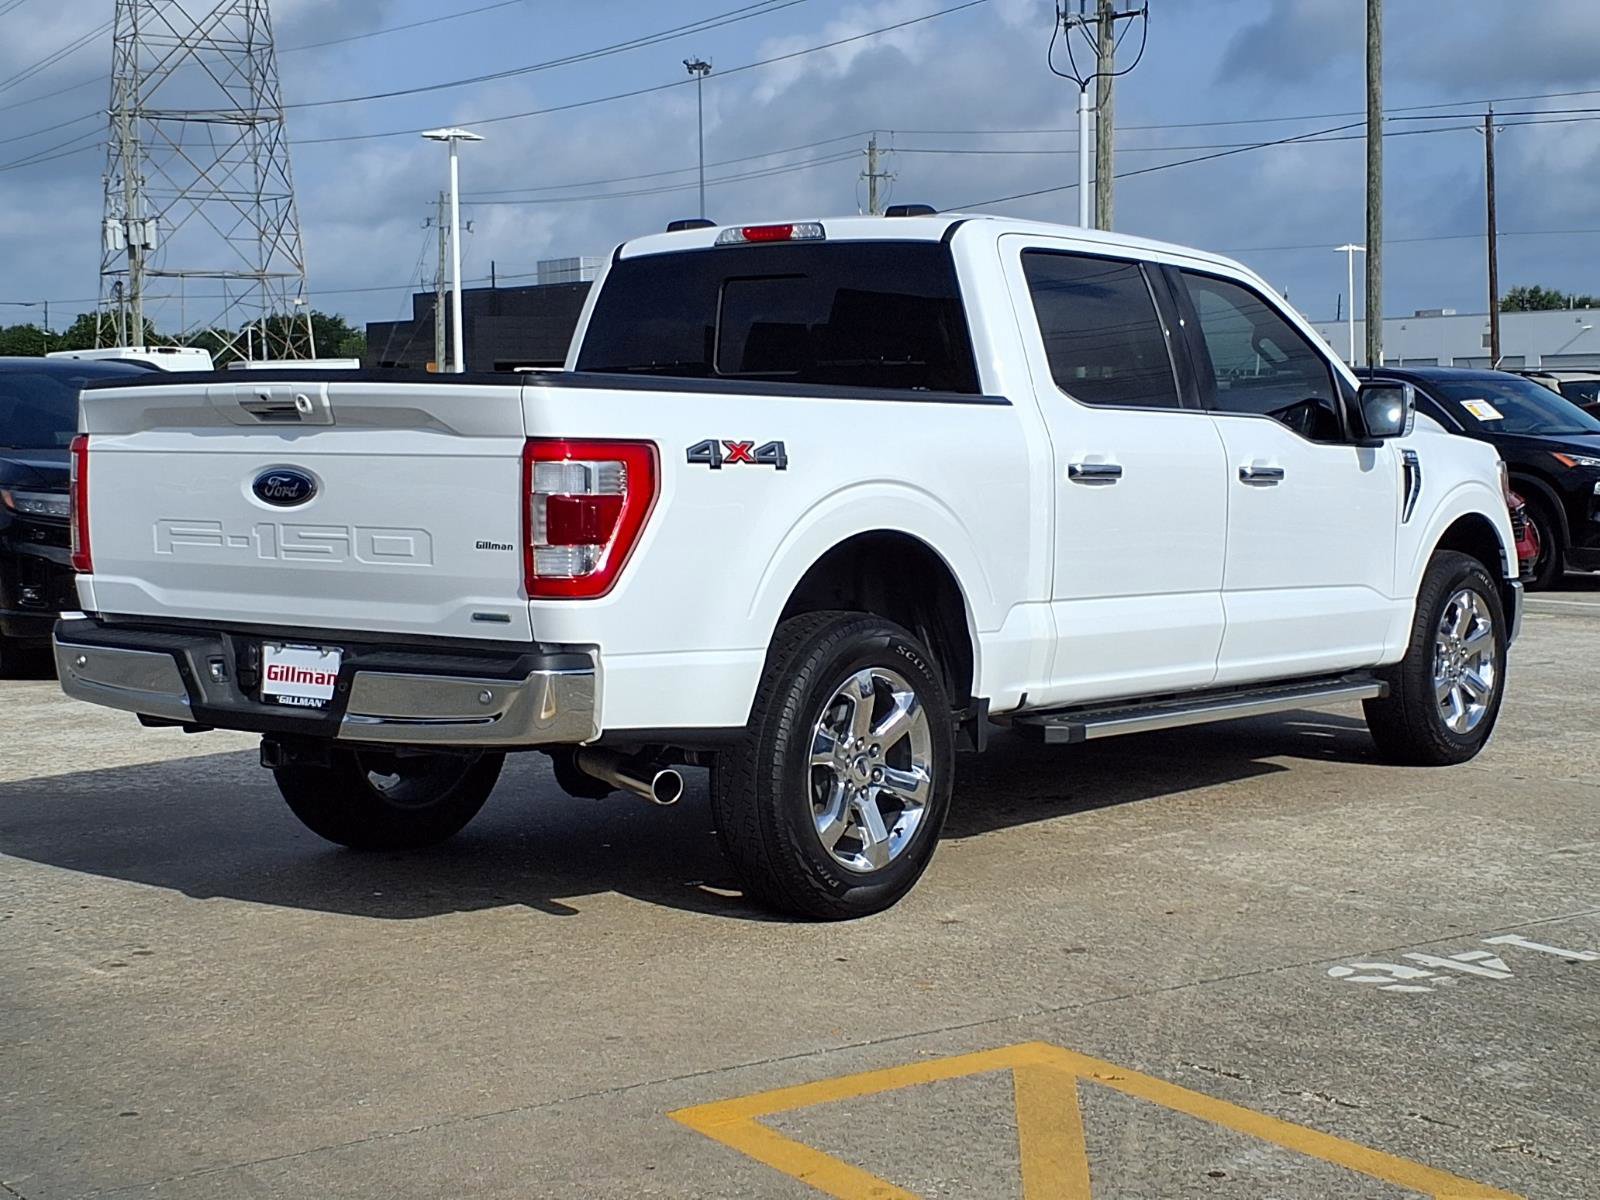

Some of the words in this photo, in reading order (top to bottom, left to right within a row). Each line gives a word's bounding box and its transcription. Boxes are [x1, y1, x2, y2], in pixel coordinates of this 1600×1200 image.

[264, 475, 300, 498] Ford
[153, 518, 434, 567] F-150
[475, 540, 514, 551] Gillman
[267, 664, 338, 686] Gillman
